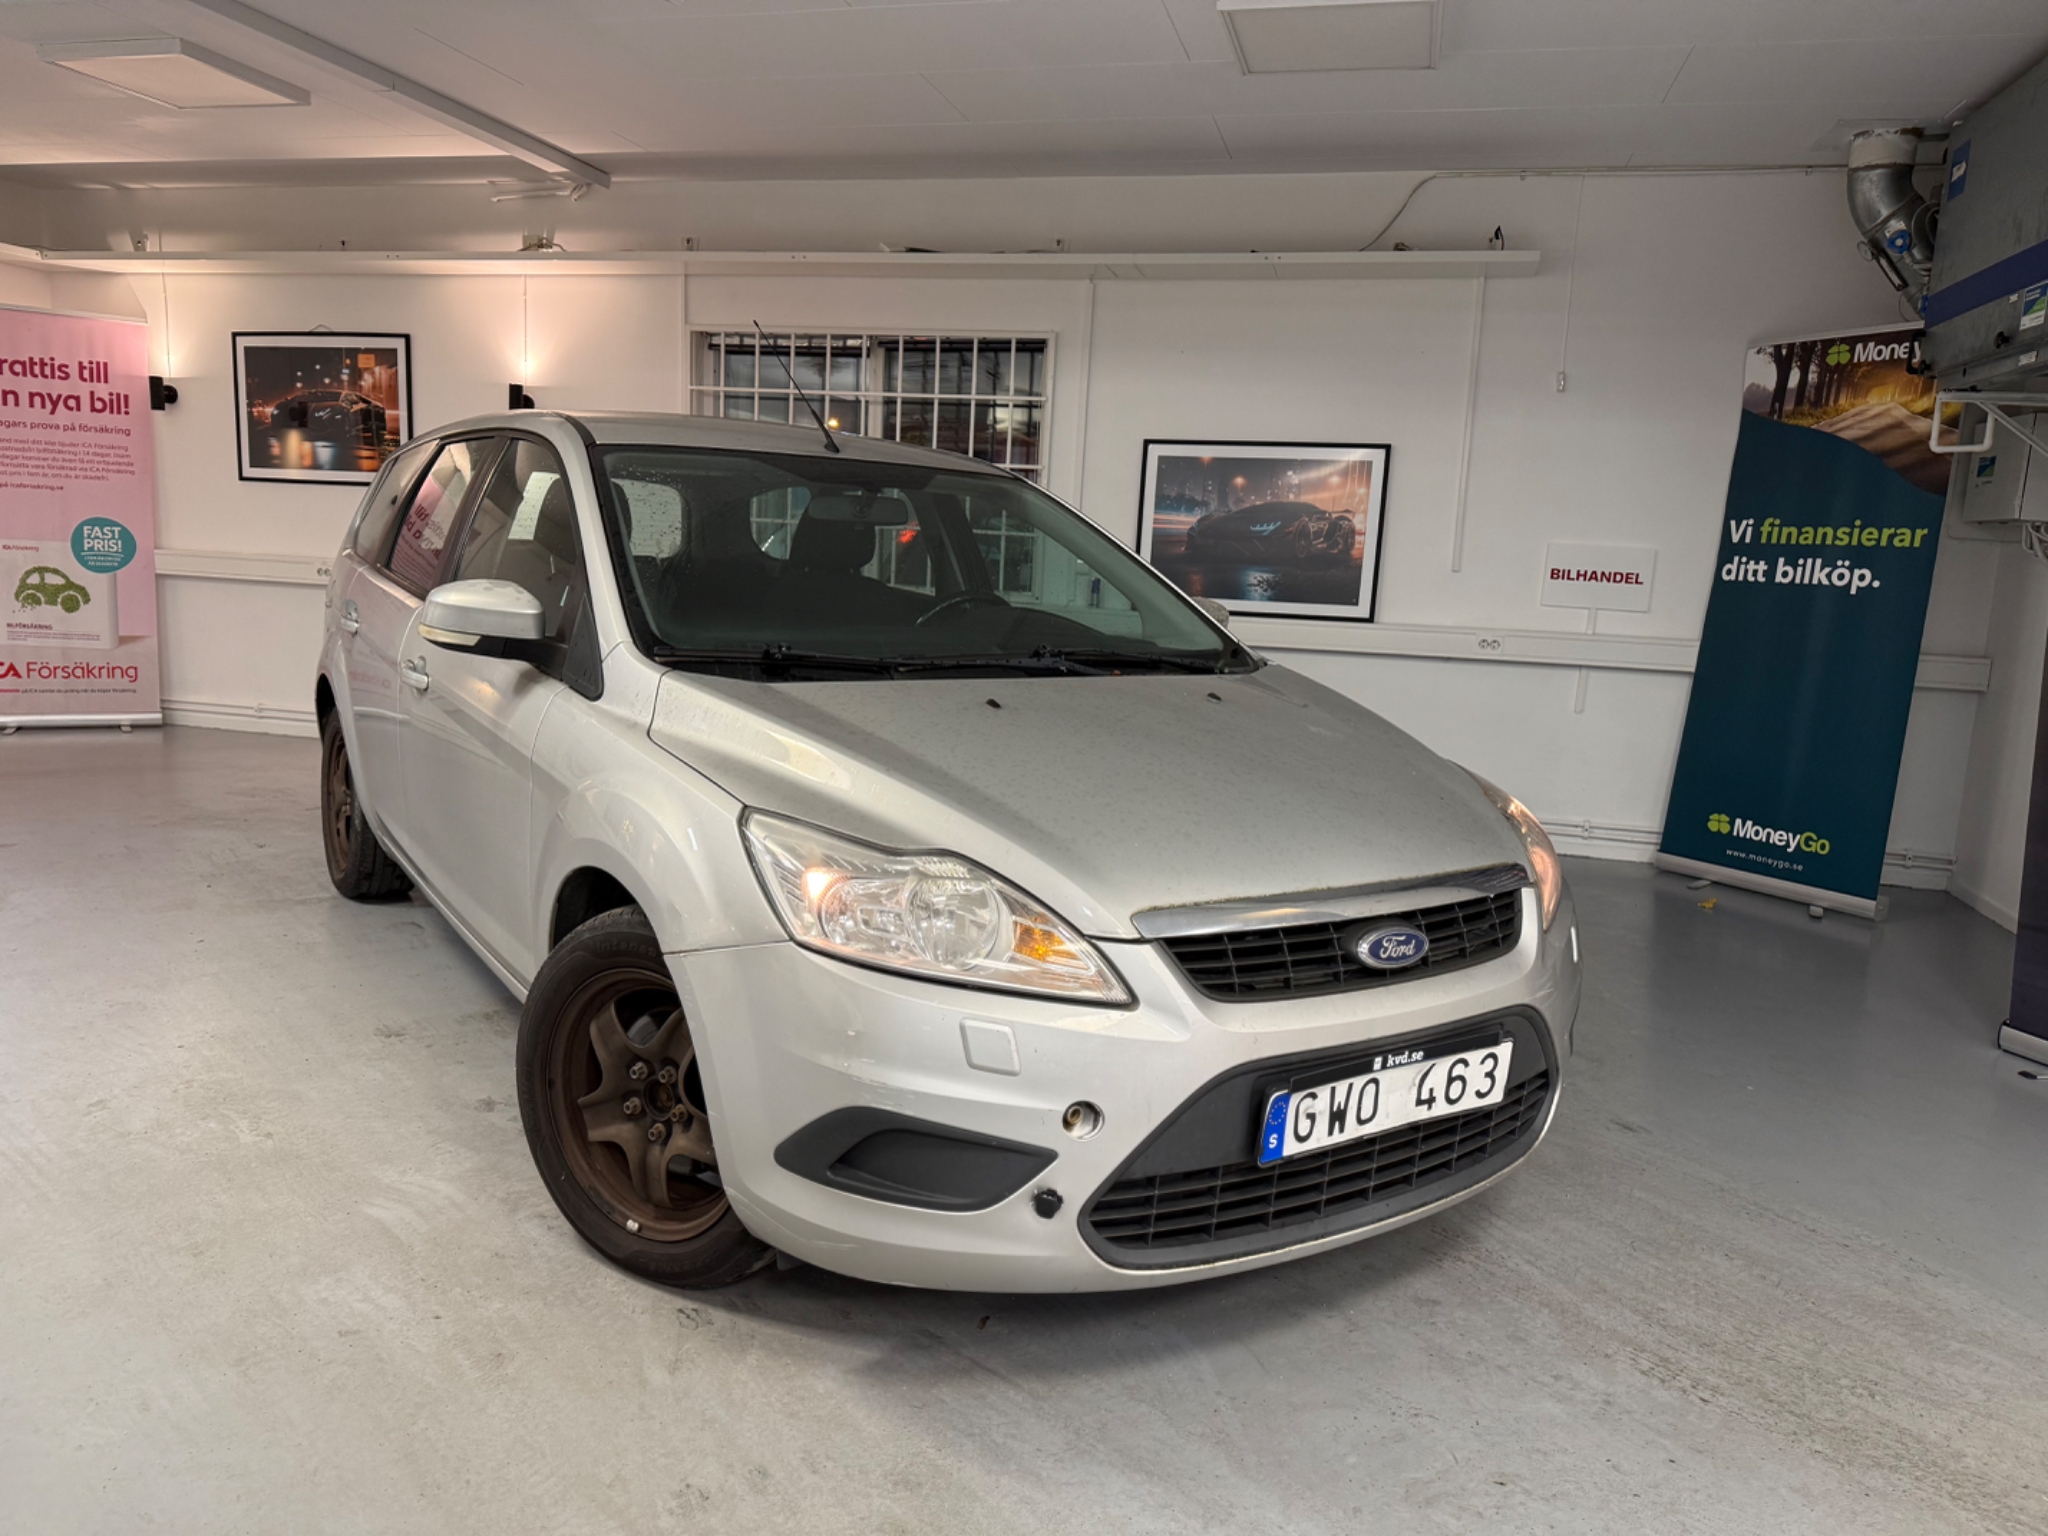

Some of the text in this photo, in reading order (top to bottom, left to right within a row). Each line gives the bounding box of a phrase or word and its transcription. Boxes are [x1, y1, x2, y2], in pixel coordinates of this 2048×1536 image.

[1853, 341, 1921, 363] Money
[78, 360, 108, 384] till
[28, 391, 81, 415] nya
[89, 390, 130, 415] bil!
[30, 422, 60, 430] prova
[62, 422, 76, 432] på
[79, 423, 131, 437] försäkring
[83, 525, 121, 540] FAST
[1729, 517, 1928, 548] Vi finansierar
[84, 538, 123, 552] PRIS!
[1550, 567, 1644, 585] BILHANDEL
[1721, 556, 1880, 594] ditt bilköp.
[26, 661, 138, 683] Försäkring
[1733, 817, 1830, 855] MoneyGo
[1726, 848, 1803, 872] www.moneygo.se
[1380, 935, 1416, 959] Ford
[1386, 1050, 1424, 1067] kvd.se
[1268, 1051, 1500, 1149] S GWO 463
